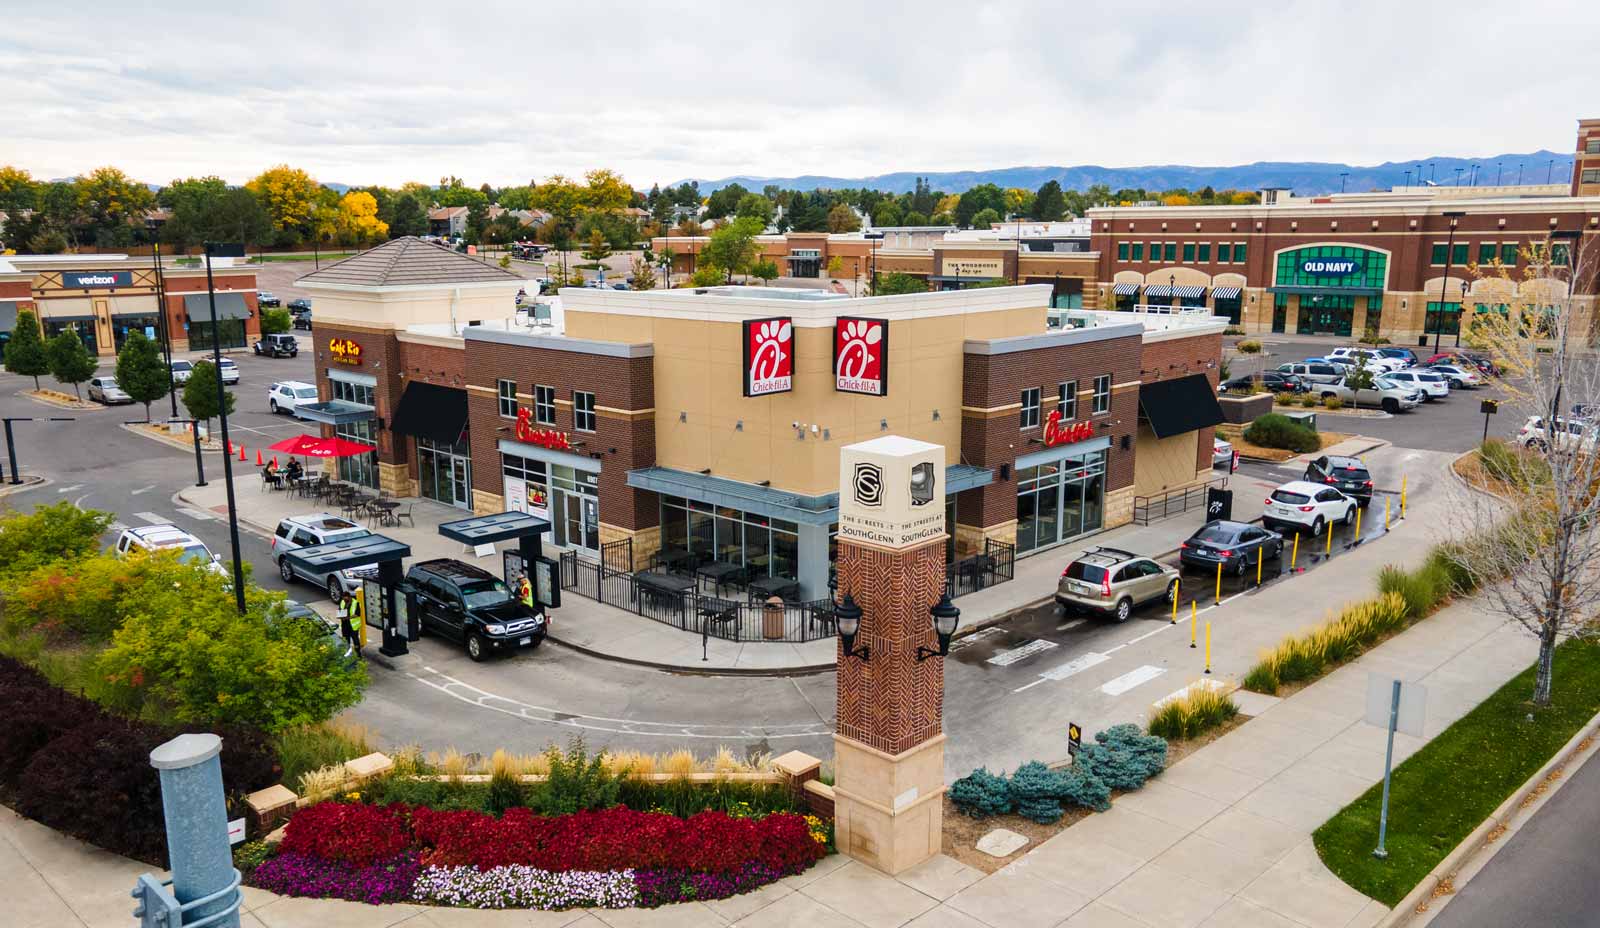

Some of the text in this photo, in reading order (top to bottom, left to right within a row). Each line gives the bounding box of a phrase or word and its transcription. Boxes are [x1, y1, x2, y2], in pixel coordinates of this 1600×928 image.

[1304, 262, 1354, 272] OLD NAVY
[77, 275, 115, 285] verizon
[752, 379, 789, 393] Chick-fil-A
[838, 378, 877, 392] Chick-fil-A
[843, 515, 855, 523] THE
[902, 522, 912, 530] THE
[913, 517, 935, 527] STREETS
